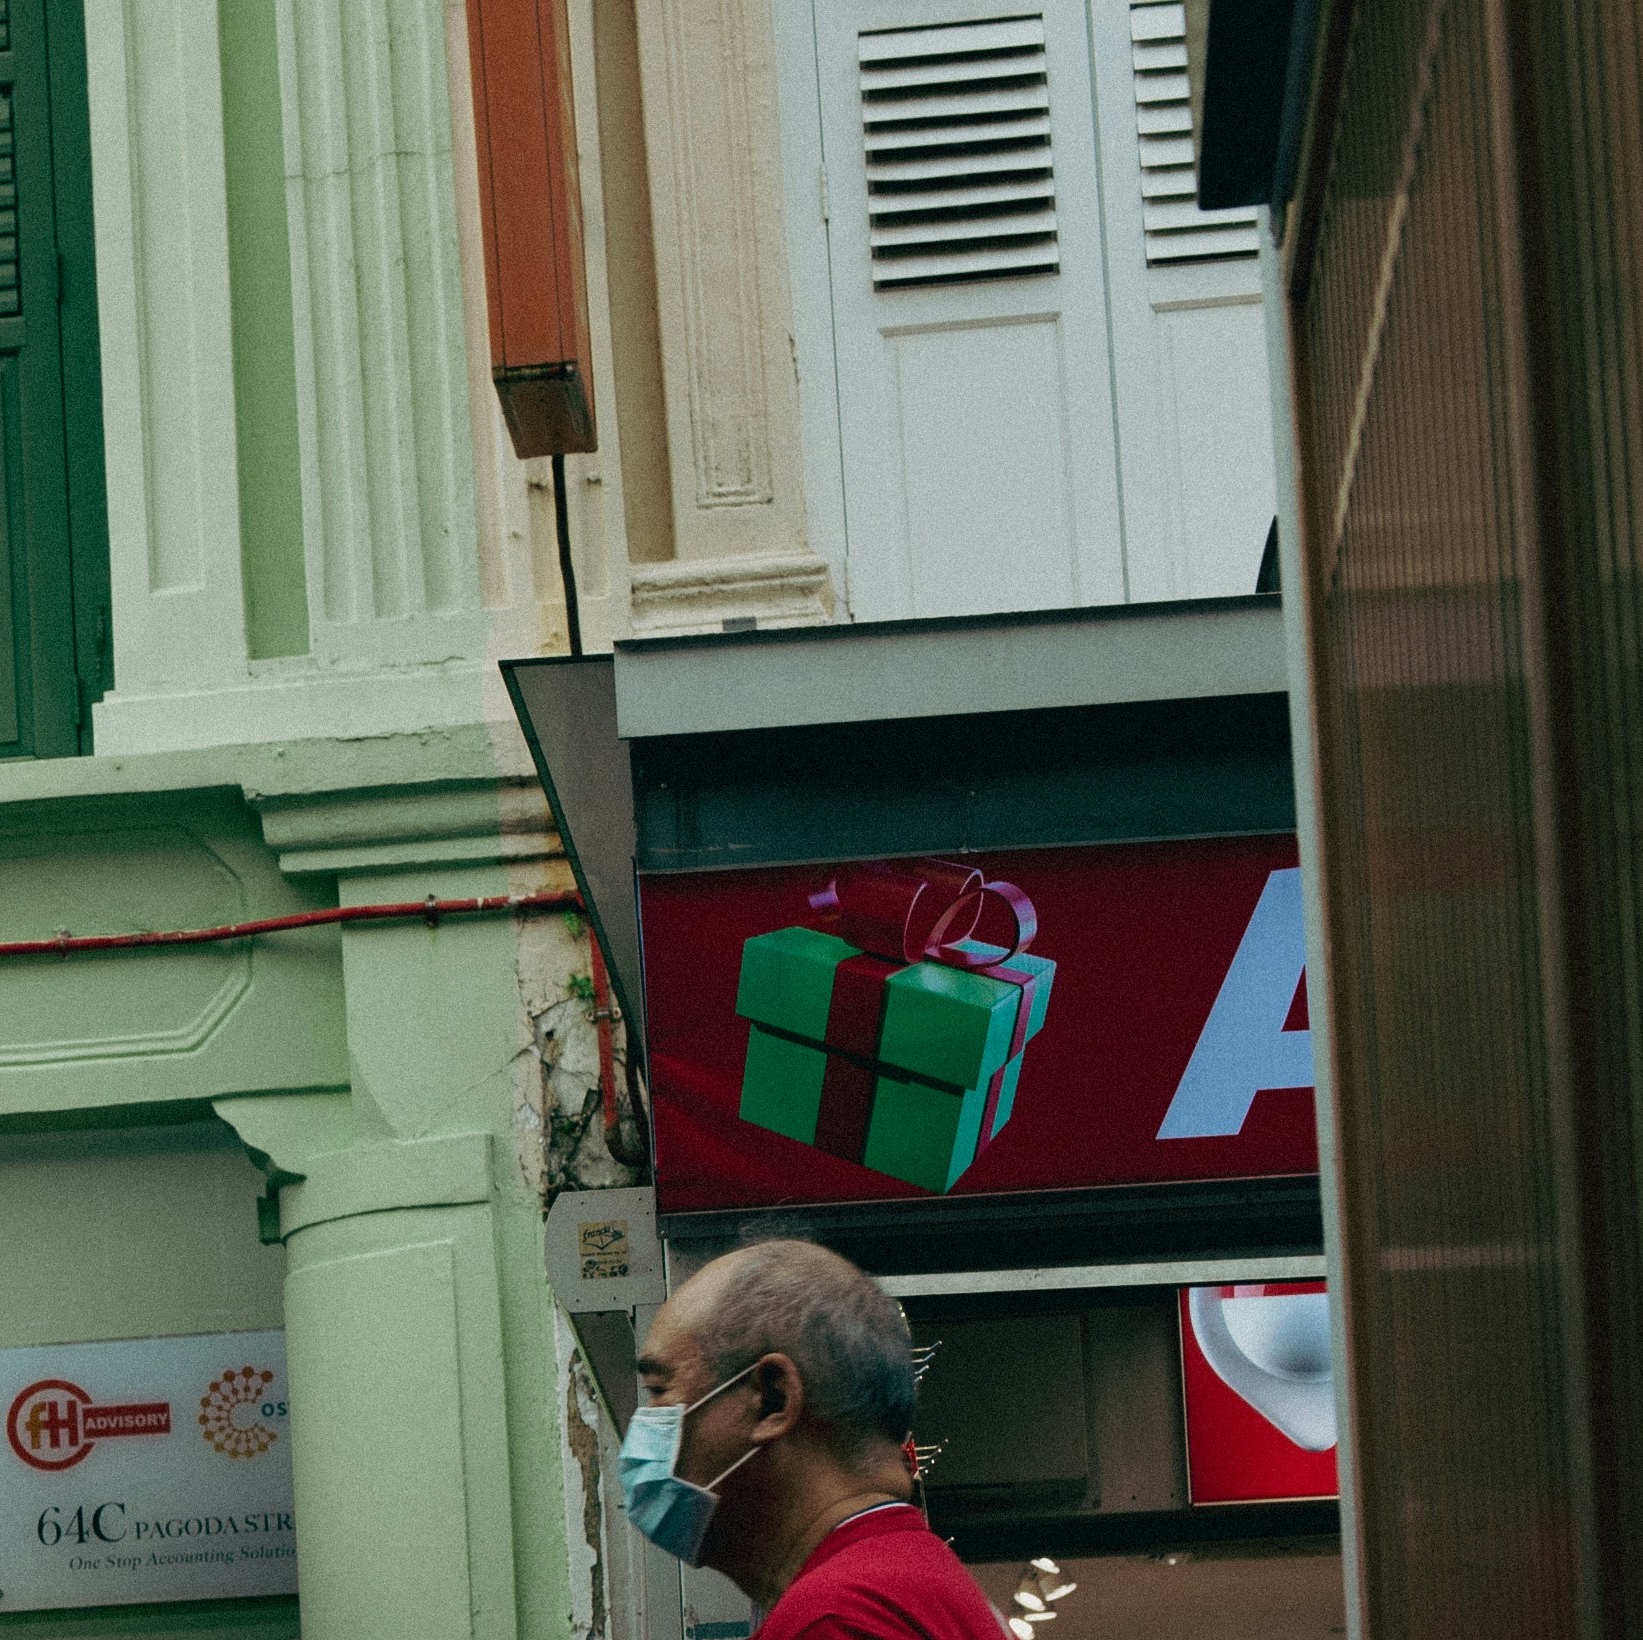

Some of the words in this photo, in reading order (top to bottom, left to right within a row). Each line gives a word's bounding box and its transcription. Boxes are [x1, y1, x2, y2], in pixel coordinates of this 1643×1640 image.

[261, 1401, 289, 1418] OS
[85, 1412, 169, 1431] ADVISORY
[37, 1501, 128, 1547] 64C
[135, 1516, 240, 1541] PAGODA
[243, 1511, 297, 1533] STR
[69, 1556, 101, 1572] One
[106, 1554, 142, 1572] Stop
[146, 1549, 235, 1568] Accounting
[240, 1544, 297, 1561] Solutio
